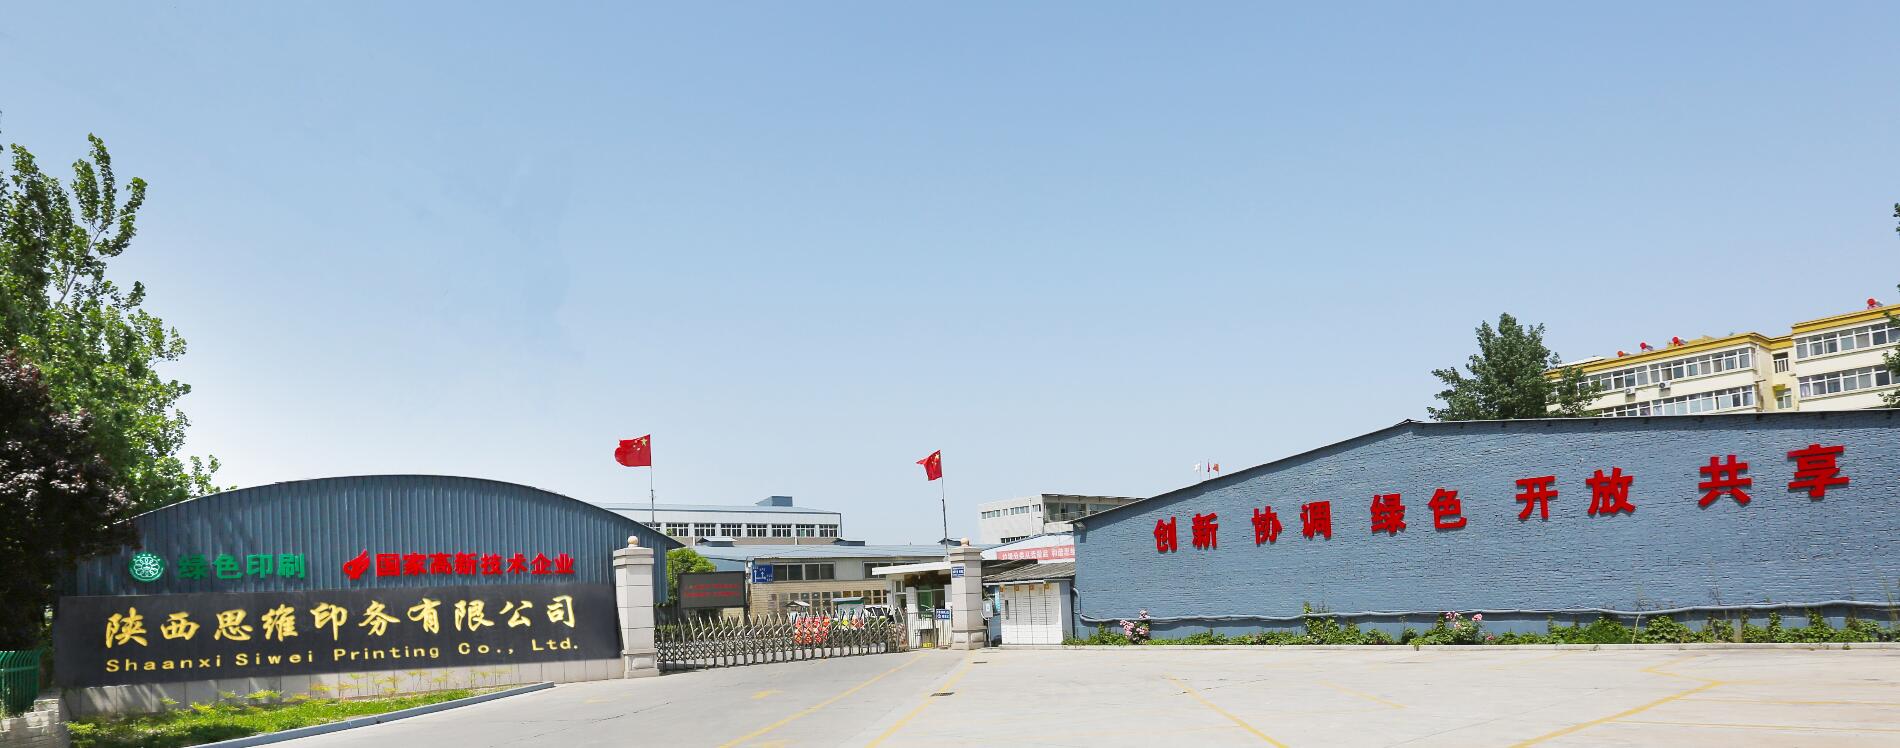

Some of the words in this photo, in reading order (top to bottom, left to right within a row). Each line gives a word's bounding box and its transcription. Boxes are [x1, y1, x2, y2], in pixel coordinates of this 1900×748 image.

[1153, 513, 1219, 553] 创新
[1251, 501, 1333, 545] 协调
[1370, 488, 1467, 533] 绿色
[1515, 468, 1635, 520] 开放
[1698, 444, 1850, 507] 共享
[176, 552, 306, 580] 绿色印刷
[375, 552, 575, 577] 国家高新技术企业
[105, 595, 576, 649] 陕西思维印务有限公司
[106, 655, 221, 673] Shaanxi
[235, 651, 313, 666] Siwei
[333, 646, 439, 662] Printing
[458, 642, 514, 655] Co.,
[531, 637, 578, 652] Ltd.
